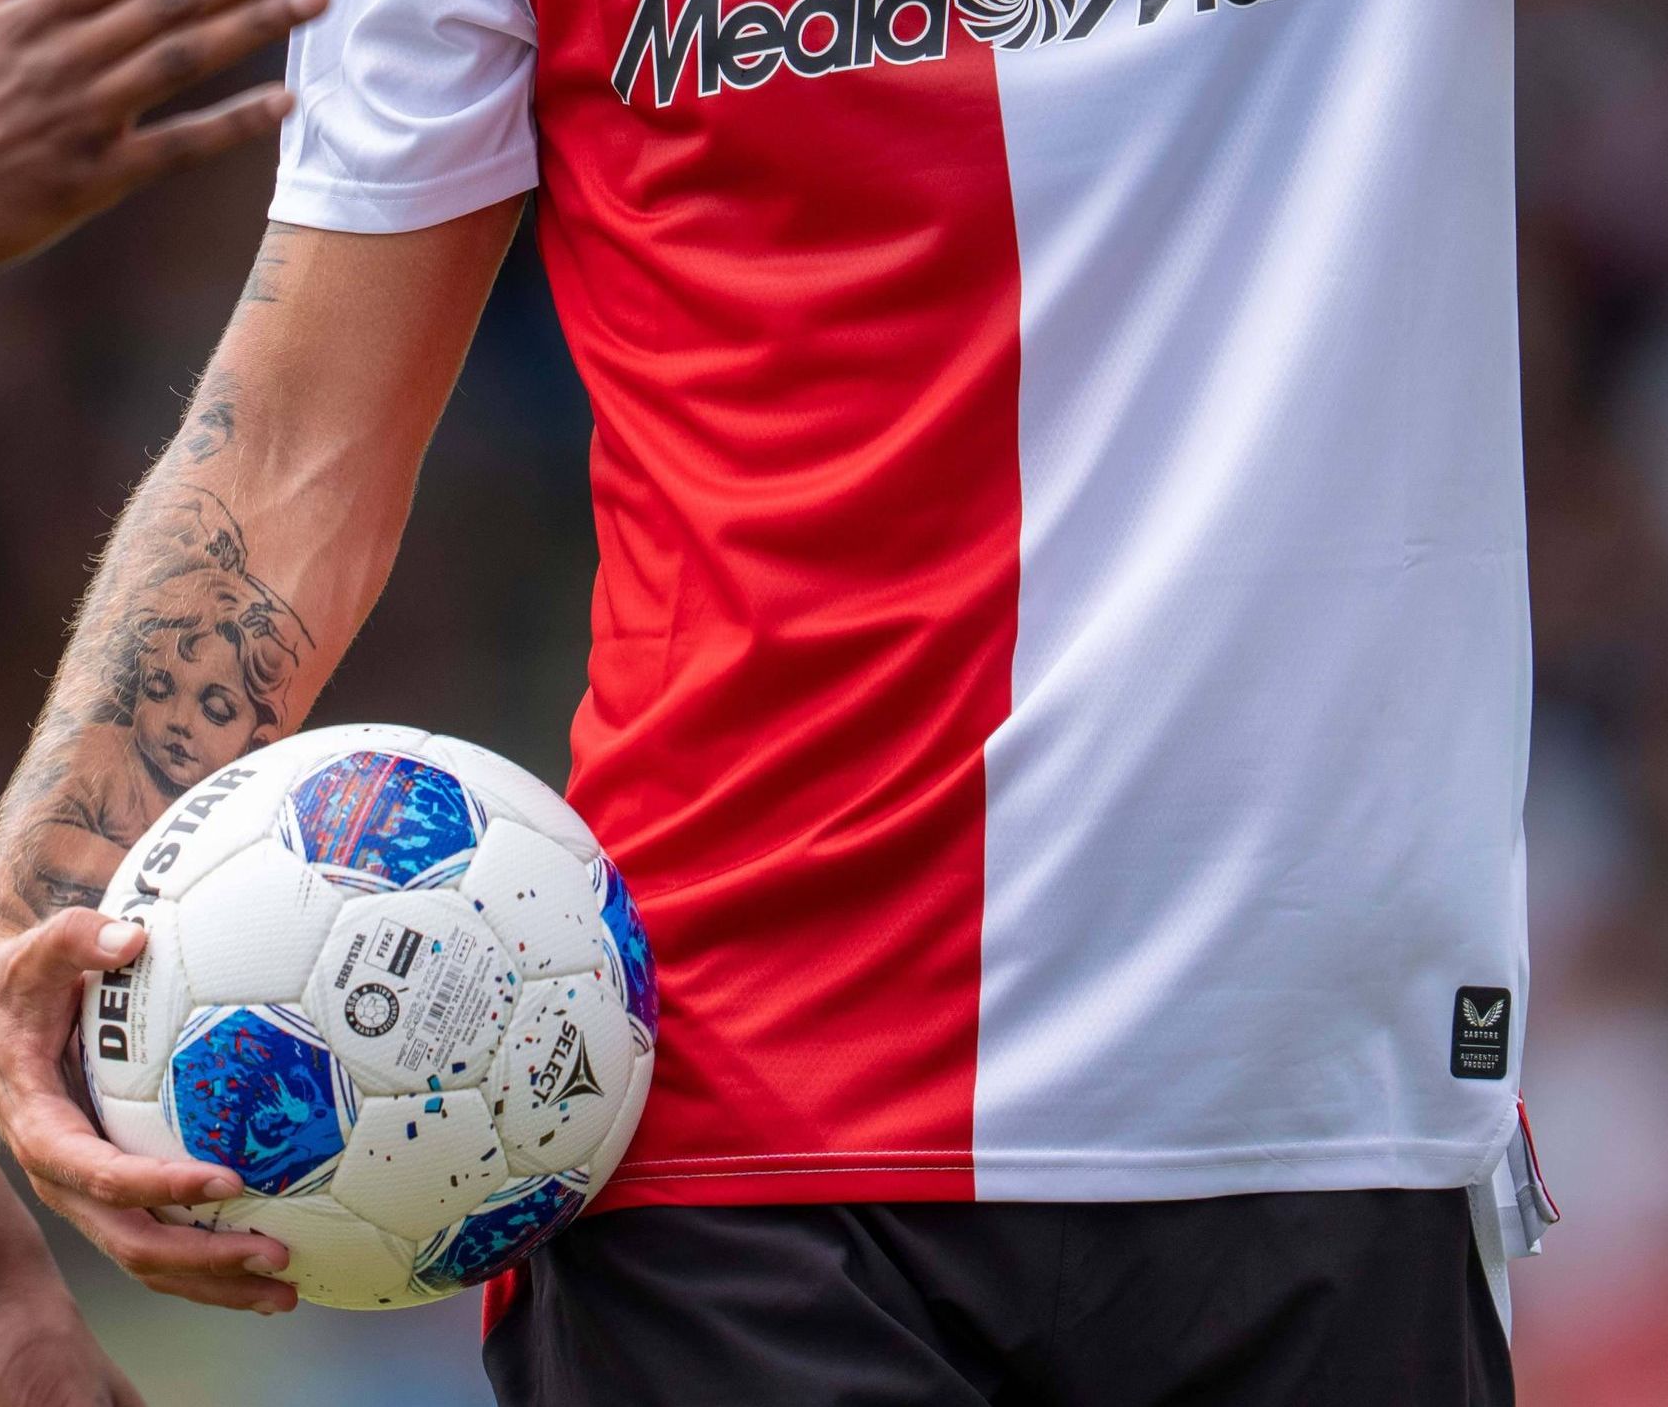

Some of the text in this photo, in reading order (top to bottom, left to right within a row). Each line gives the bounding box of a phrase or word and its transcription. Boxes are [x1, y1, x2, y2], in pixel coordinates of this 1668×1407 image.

[98, 767, 258, 1063] DERYSTAR
[376, 931, 394, 958] FIFA
[335, 933, 367, 989] DERBYSTAR
[533, 1020, 577, 1104] SELECT
